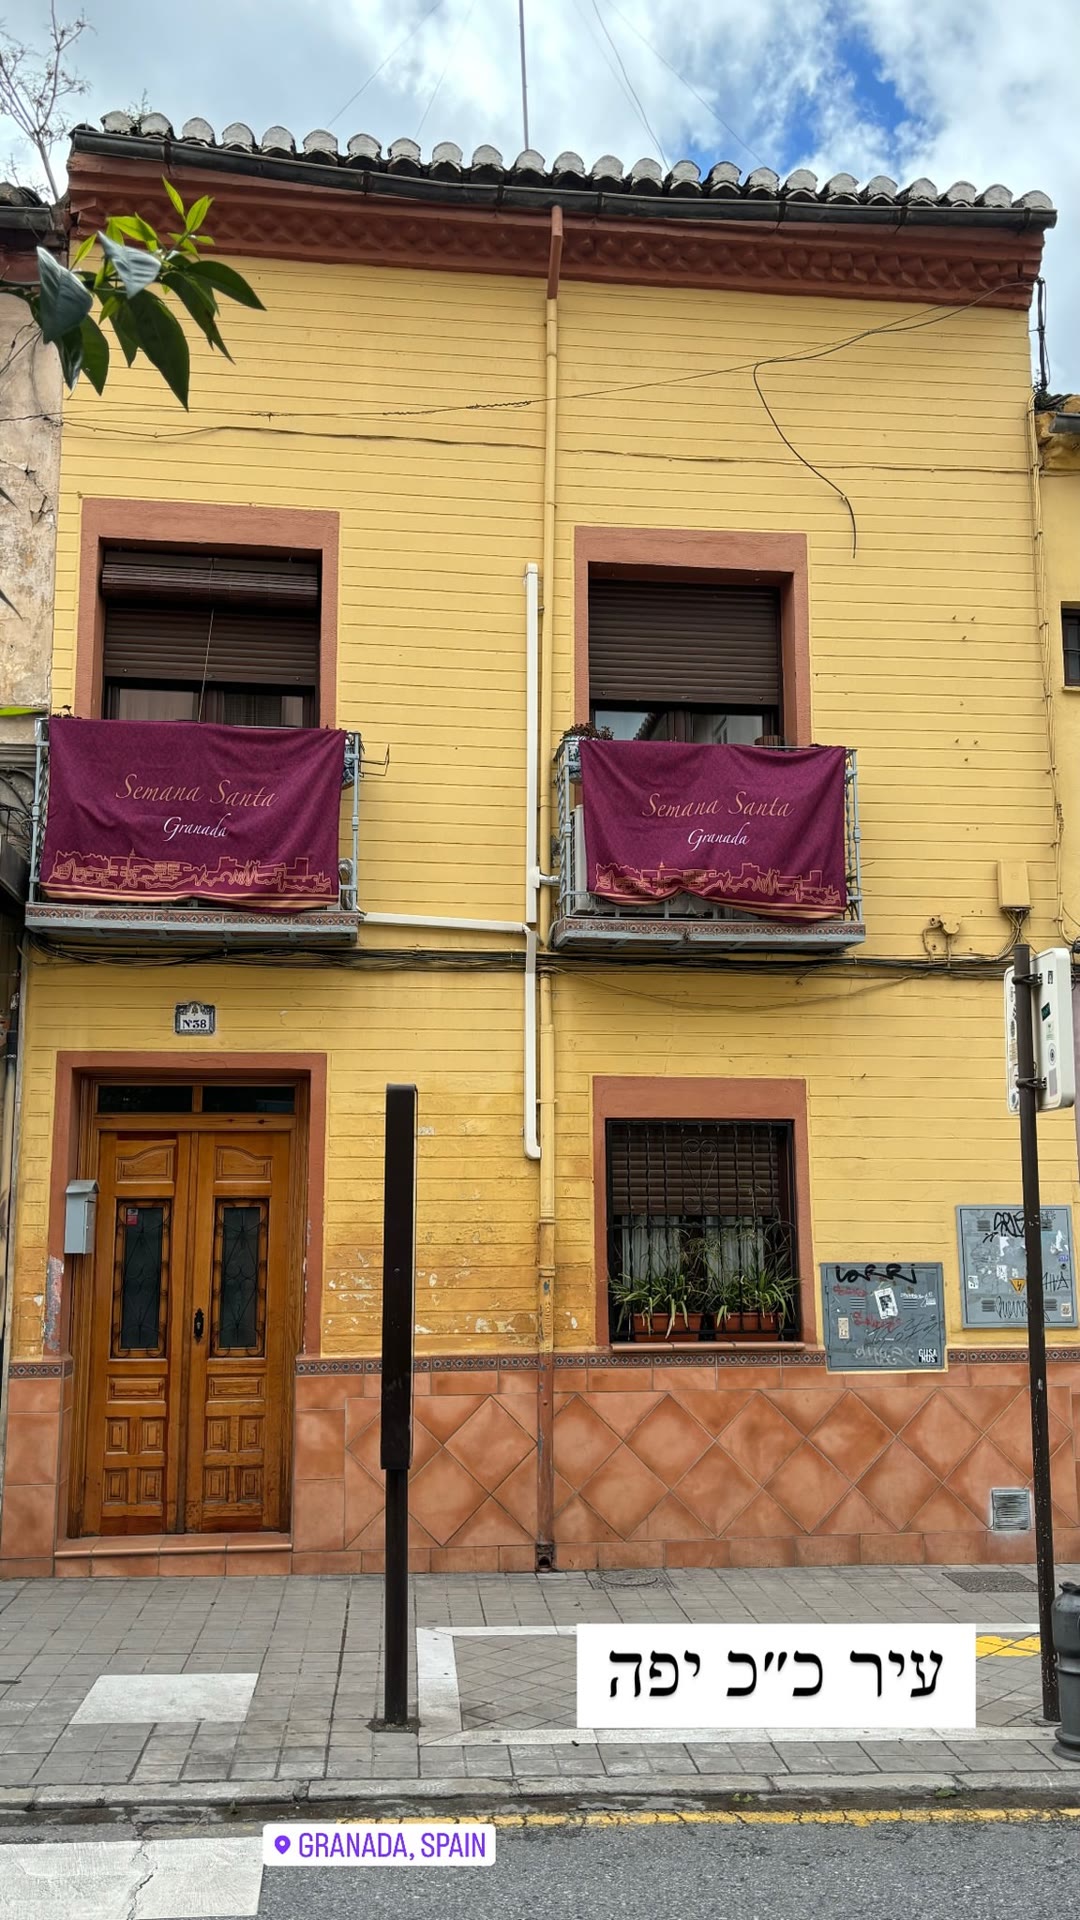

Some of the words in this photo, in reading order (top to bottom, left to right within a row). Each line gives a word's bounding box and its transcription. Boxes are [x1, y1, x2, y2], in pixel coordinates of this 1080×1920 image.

[115, 773, 203, 801] Semana
[210, 779, 278, 807] Santa
[642, 792, 721, 818] Semana
[728, 790, 794, 817] Santa
[163, 812, 232, 842] Granada
[687, 821, 751, 852] Granada
